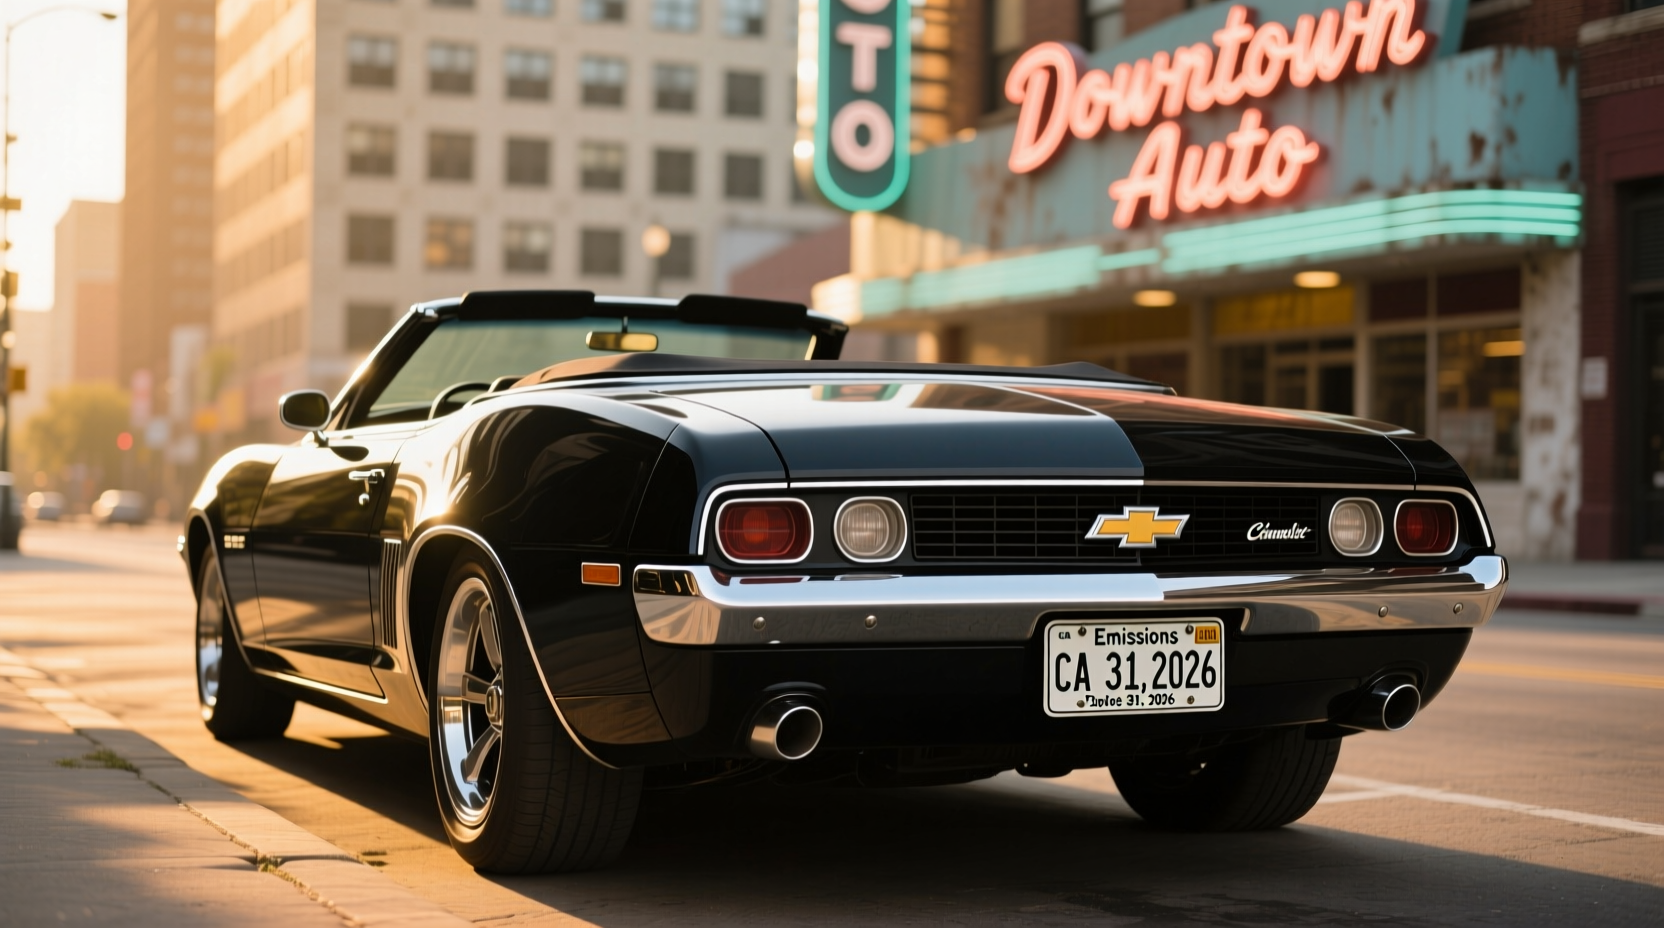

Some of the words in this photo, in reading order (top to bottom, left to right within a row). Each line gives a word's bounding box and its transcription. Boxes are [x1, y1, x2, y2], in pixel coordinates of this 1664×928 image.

[831, 0, 895, 172] TO
[1005, 0, 1426, 174] Downtown
[1108, 108, 1319, 229] Auto
[1055, 652, 1091, 692] CA
[1105, 650, 1217, 694] 31,2026
[1094, 627, 1179, 646] Emissions
[1126, 694, 1145, 707] 31,
